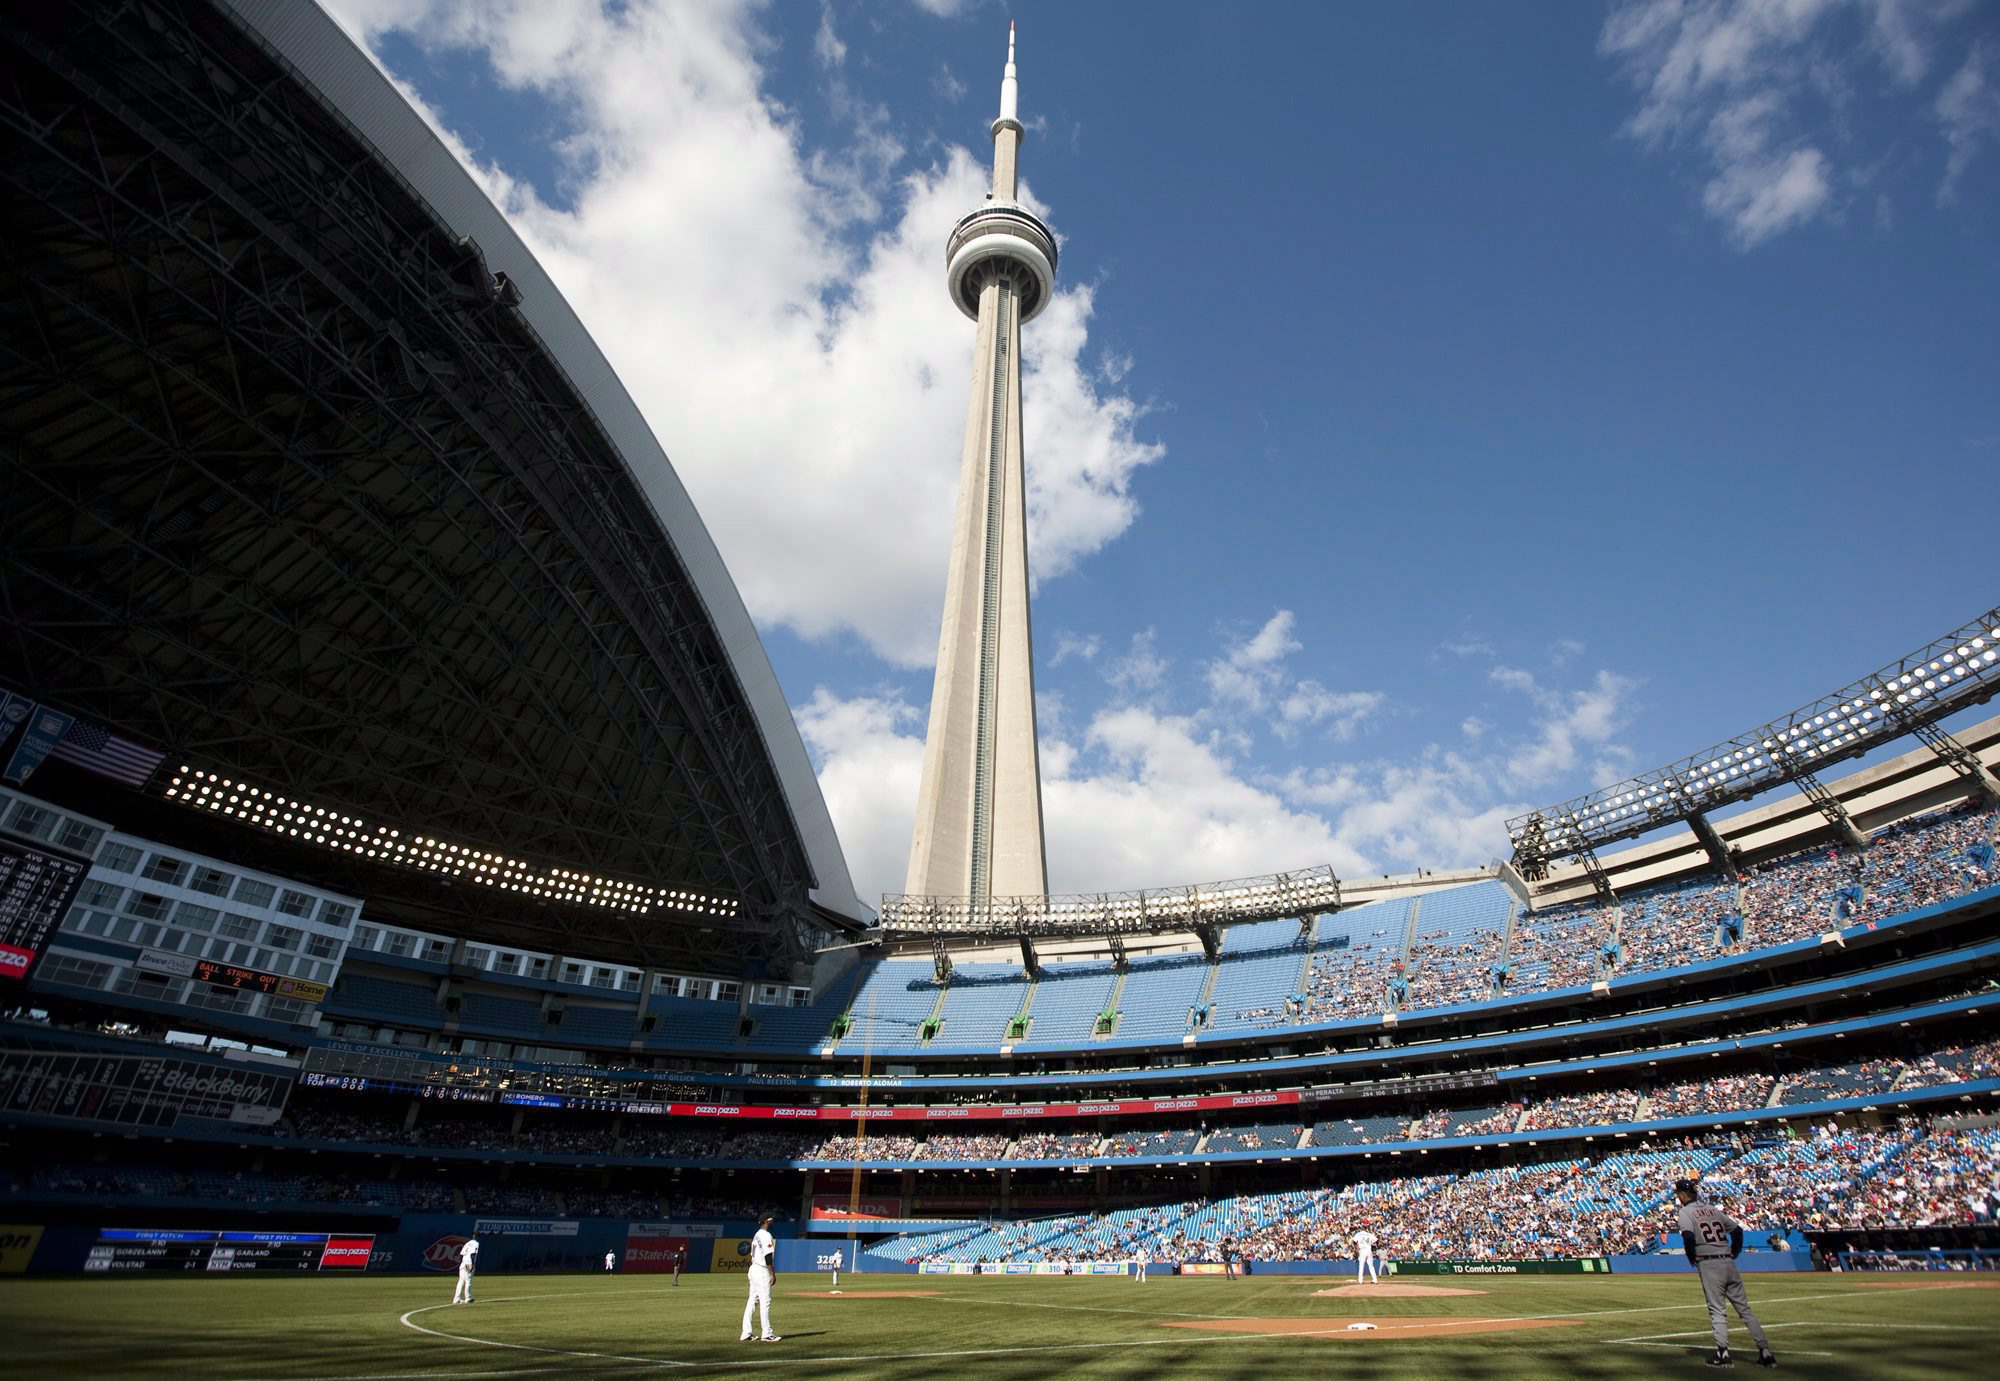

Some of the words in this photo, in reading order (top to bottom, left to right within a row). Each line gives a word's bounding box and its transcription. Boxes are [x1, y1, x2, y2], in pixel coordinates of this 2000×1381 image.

[25, 853, 43, 863] AVG
[49, 861, 61, 869] HR
[42, 887, 46, 895] 1
[31, 903, 38, 912] 2
[38, 925, 48, 934] 14
[32, 933, 44, 942] 21
[14, 938, 18, 946] 1
[31, 942, 38, 950] 11
[142, 954, 168, 964] Bruce
[199, 962, 220, 973] BALL
[226, 968, 255, 980] STRIKE
[260, 975, 278, 984] OUT
[202, 971, 210, 980] 3
[233, 978, 242, 986] 2
[263, 984, 269, 992] 1
[296, 982, 324, 994] Home
[328, 1042, 353, 1051] LEVEL
[370, 1047, 421, 1060] EXCELLENCE
[469, 1058, 491, 1067] DAVE
[578, 1069, 608, 1077] GASTON
[667, 1074, 696, 1082] GILLICK
[163, 1070, 269, 1104] BlackBerry
[1233, 1096, 1254, 1106] pizza
[1255, 1095, 1277, 1104] pizza
[1078, 1106, 1098, 1114] pizza
[1099, 1105, 1120, 1114] pizza
[1154, 1102, 1175, 1111] pizza
[1176, 1100, 1197, 1109] pizza
[695, 1106, 717, 1115] pizza
[717, 1106, 739, 1116] pizza
[774, 1108, 795, 1116] pizza
[796, 1108, 817, 1117] pizza
[850, 1109, 871, 1118] pizza
[872, 1109, 893, 1118] pizza
[926, 1110, 947, 1118] pizza
[948, 1109, 968, 1118] pizza
[1002, 1108, 1022, 1117] pizza
[1023, 1108, 1044, 1116] pizza
[482, 1223, 525, 1232] TORONTO
[526, 1224, 549, 1232] STAR
[1699, 1221, 1728, 1243] 22
[347, 1248, 370, 1256] pizza
[370, 1252, 394, 1262] 375
[816, 1255, 834, 1264] 328
